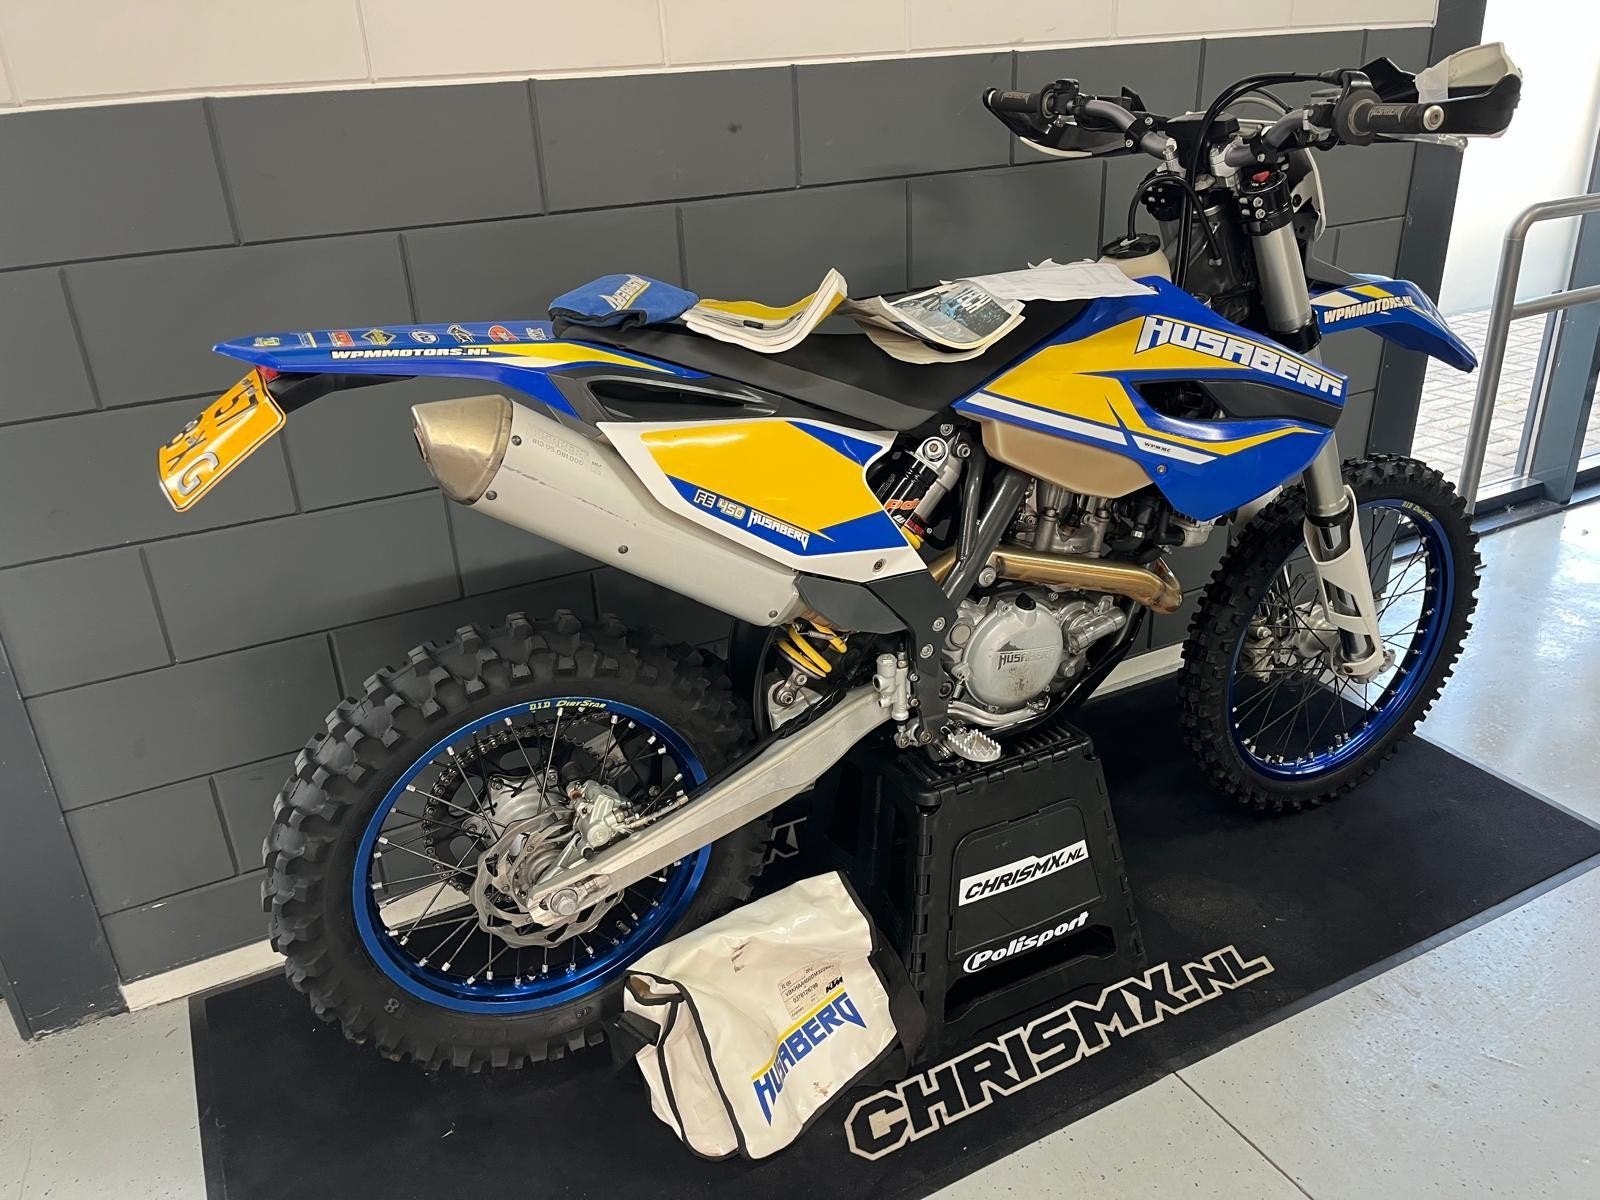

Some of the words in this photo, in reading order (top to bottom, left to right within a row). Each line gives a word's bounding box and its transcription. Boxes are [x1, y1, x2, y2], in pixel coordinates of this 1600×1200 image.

[1323, 295, 1416, 325] WPMMOTORS.NL
[331, 346, 490, 360] WPMMOTORS.NL
[693, 488, 717, 509] FE
[717, 497, 747, 520] 450
[746, 508, 811, 552] HUSABERG
[964, 846, 1086, 900] CHRISMX.NL
[962, 910, 1090, 974] Polisport
[752, 990, 868, 1128] HUSABERG
[843, 944, 1275, 1161] CHRISMX.NL
